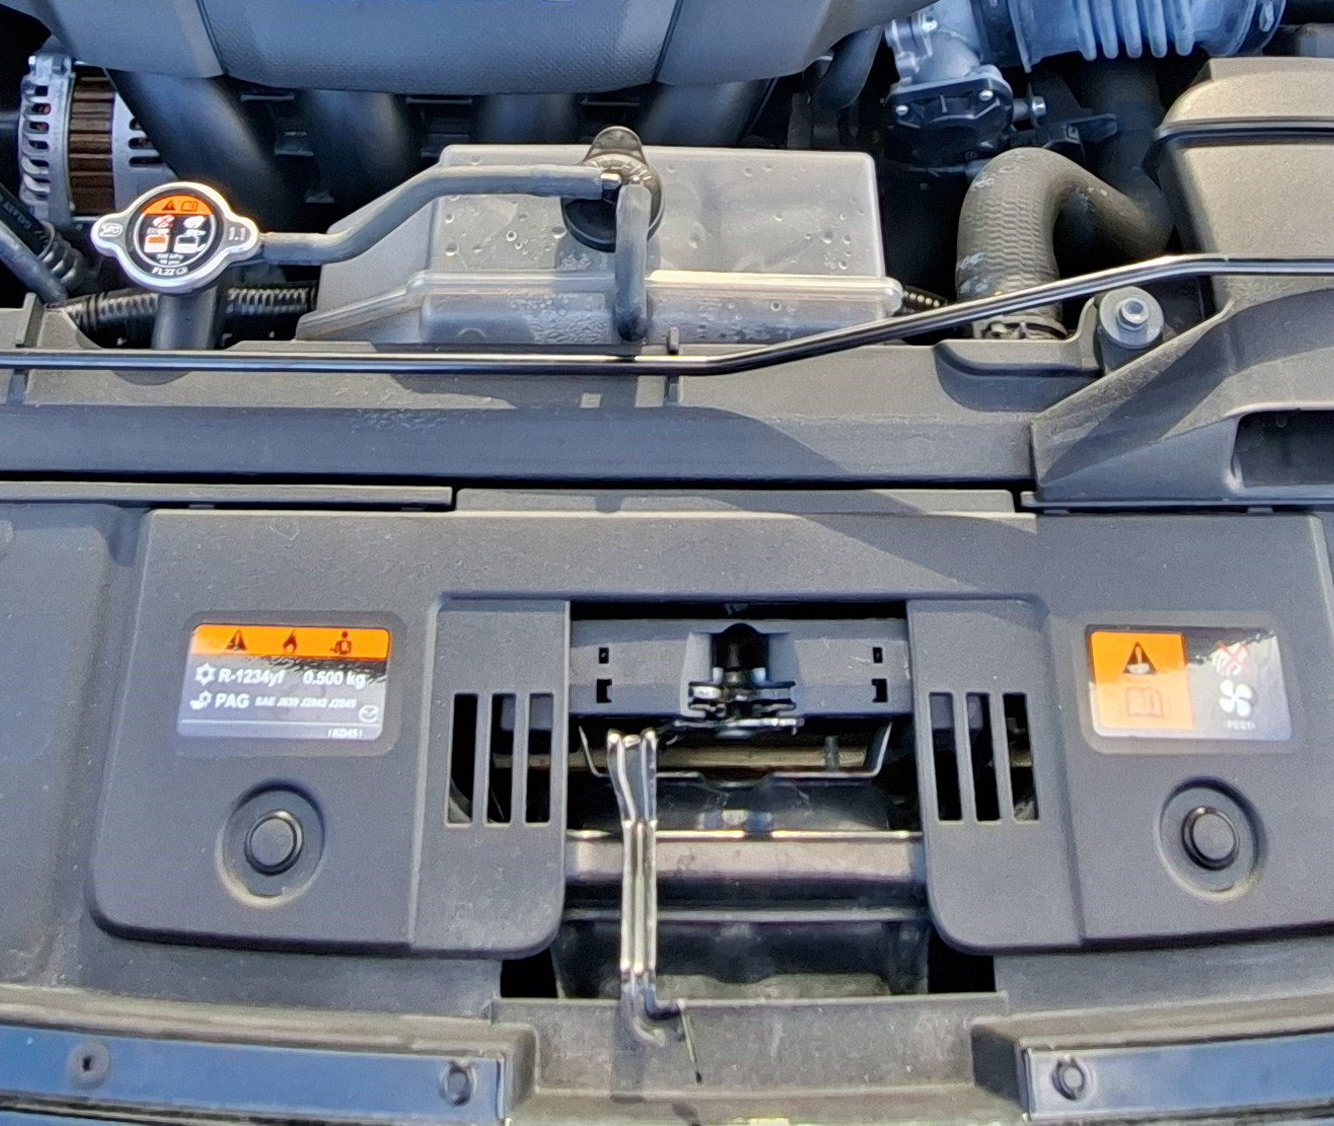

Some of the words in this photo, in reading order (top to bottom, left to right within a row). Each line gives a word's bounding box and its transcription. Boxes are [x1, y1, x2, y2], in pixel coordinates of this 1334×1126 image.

[228, 226, 247, 241] 1.1
[302, 669, 344, 686] 0.500
[346, 670, 367, 690] kg
[214, 692, 250, 709] PAG
